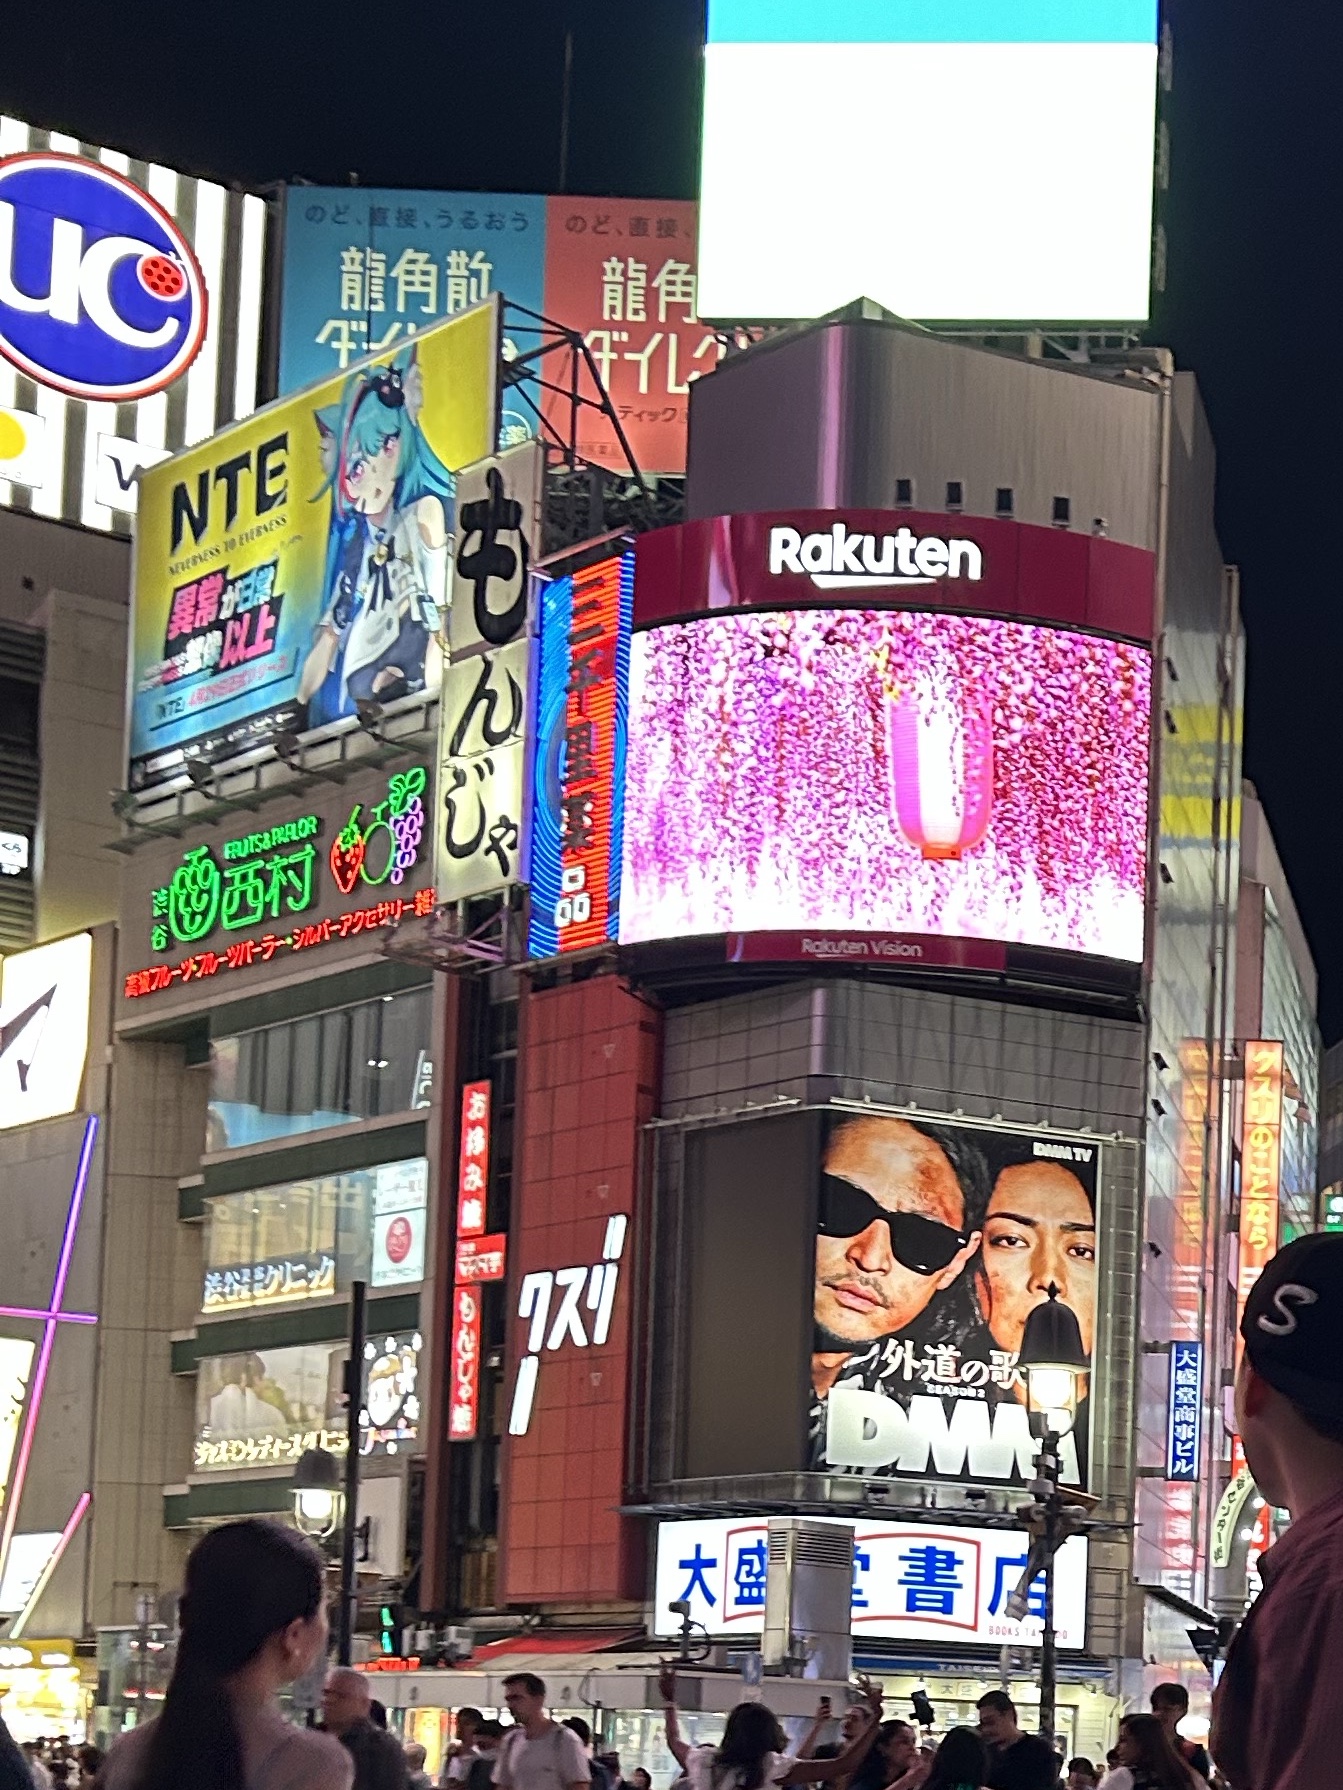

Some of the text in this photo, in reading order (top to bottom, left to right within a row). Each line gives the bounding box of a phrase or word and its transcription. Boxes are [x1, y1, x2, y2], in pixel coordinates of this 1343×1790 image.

[304, 205, 530, 233] のど、直接、うるおう
[340, 246, 493, 317] 龍角散
[601, 405, 677, 423] ティック
[170, 431, 290, 558] NTE
[769, 523, 983, 582] Rakuten
[444, 466, 528, 878] もんじゃ
[221, 842, 317, 931] 西村
[802, 937, 923, 958] Rakuten Vision
[1033, 1142, 1093, 1163] DMM TV
[1245, 1050, 1278, 1251] クスリのことなら
[879, 1337, 1028, 1390] 外道の歌
[1172, 1349, 1199, 1474] 大盛堂商事ビル
